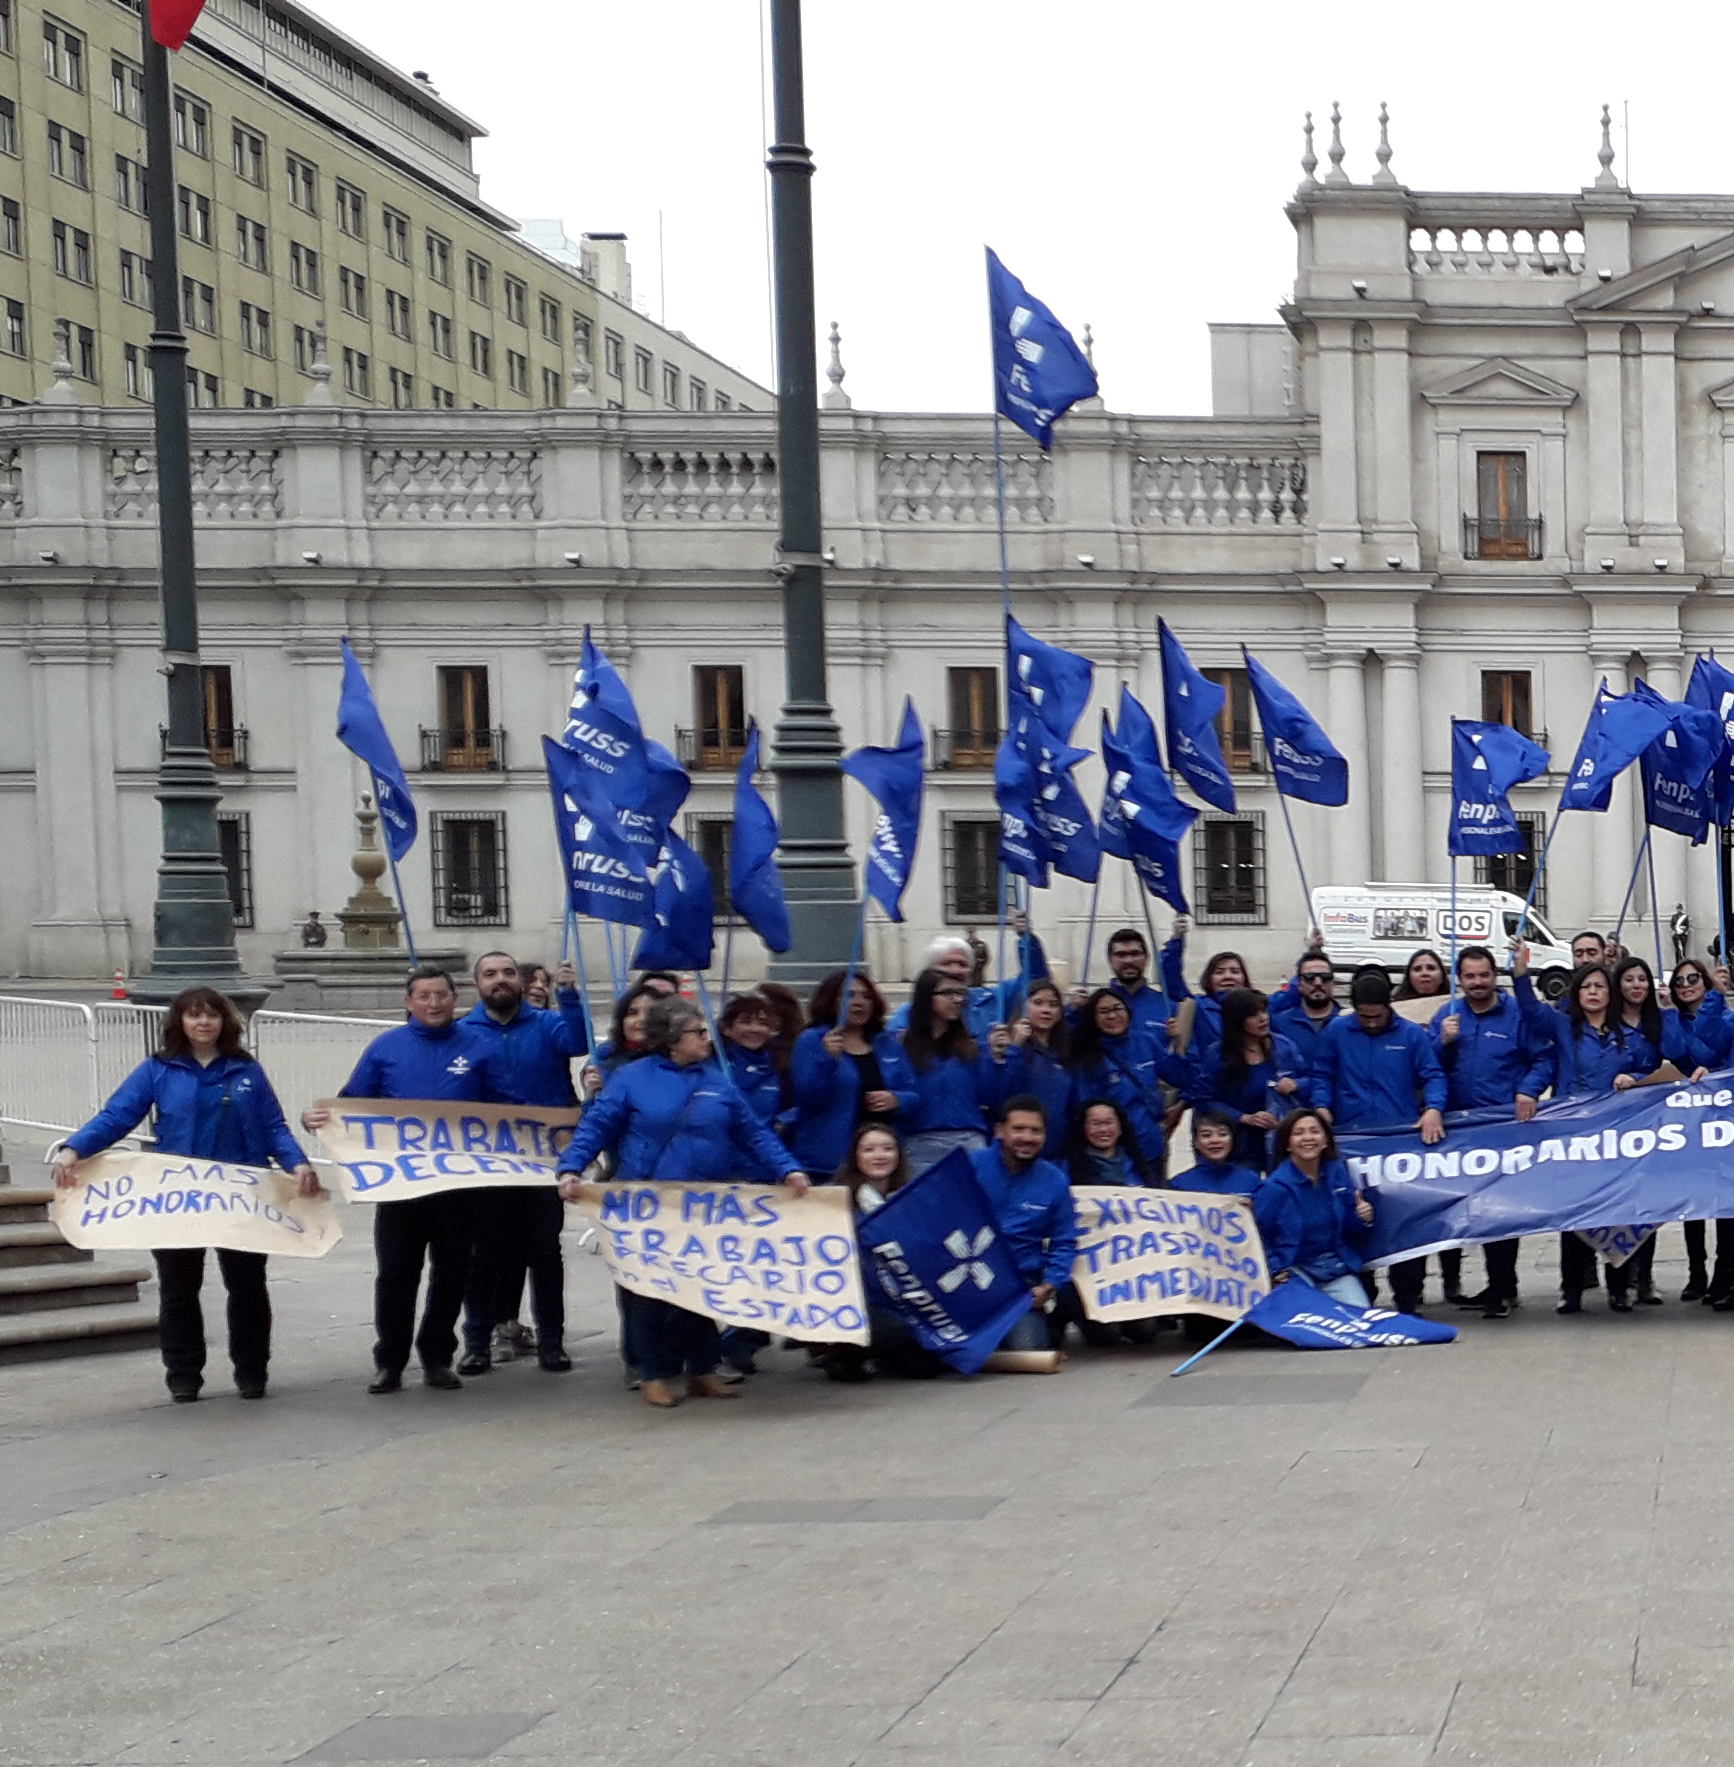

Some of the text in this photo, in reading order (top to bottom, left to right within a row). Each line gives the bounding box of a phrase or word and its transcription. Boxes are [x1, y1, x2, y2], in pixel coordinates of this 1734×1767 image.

[1443, 915, 1485, 932] DOS
[1665, 1090, 1733, 1110] Que
[1346, 1123, 1687, 1189] HONORARIOS
[84, 1175, 134, 1205] NO
[602, 1189, 660, 1222] NO
[80, 1189, 305, 1234] HONORARIOS
[610, 1228, 852, 1267] TRABAJO
[703, 1289, 866, 1330] ESTADO
